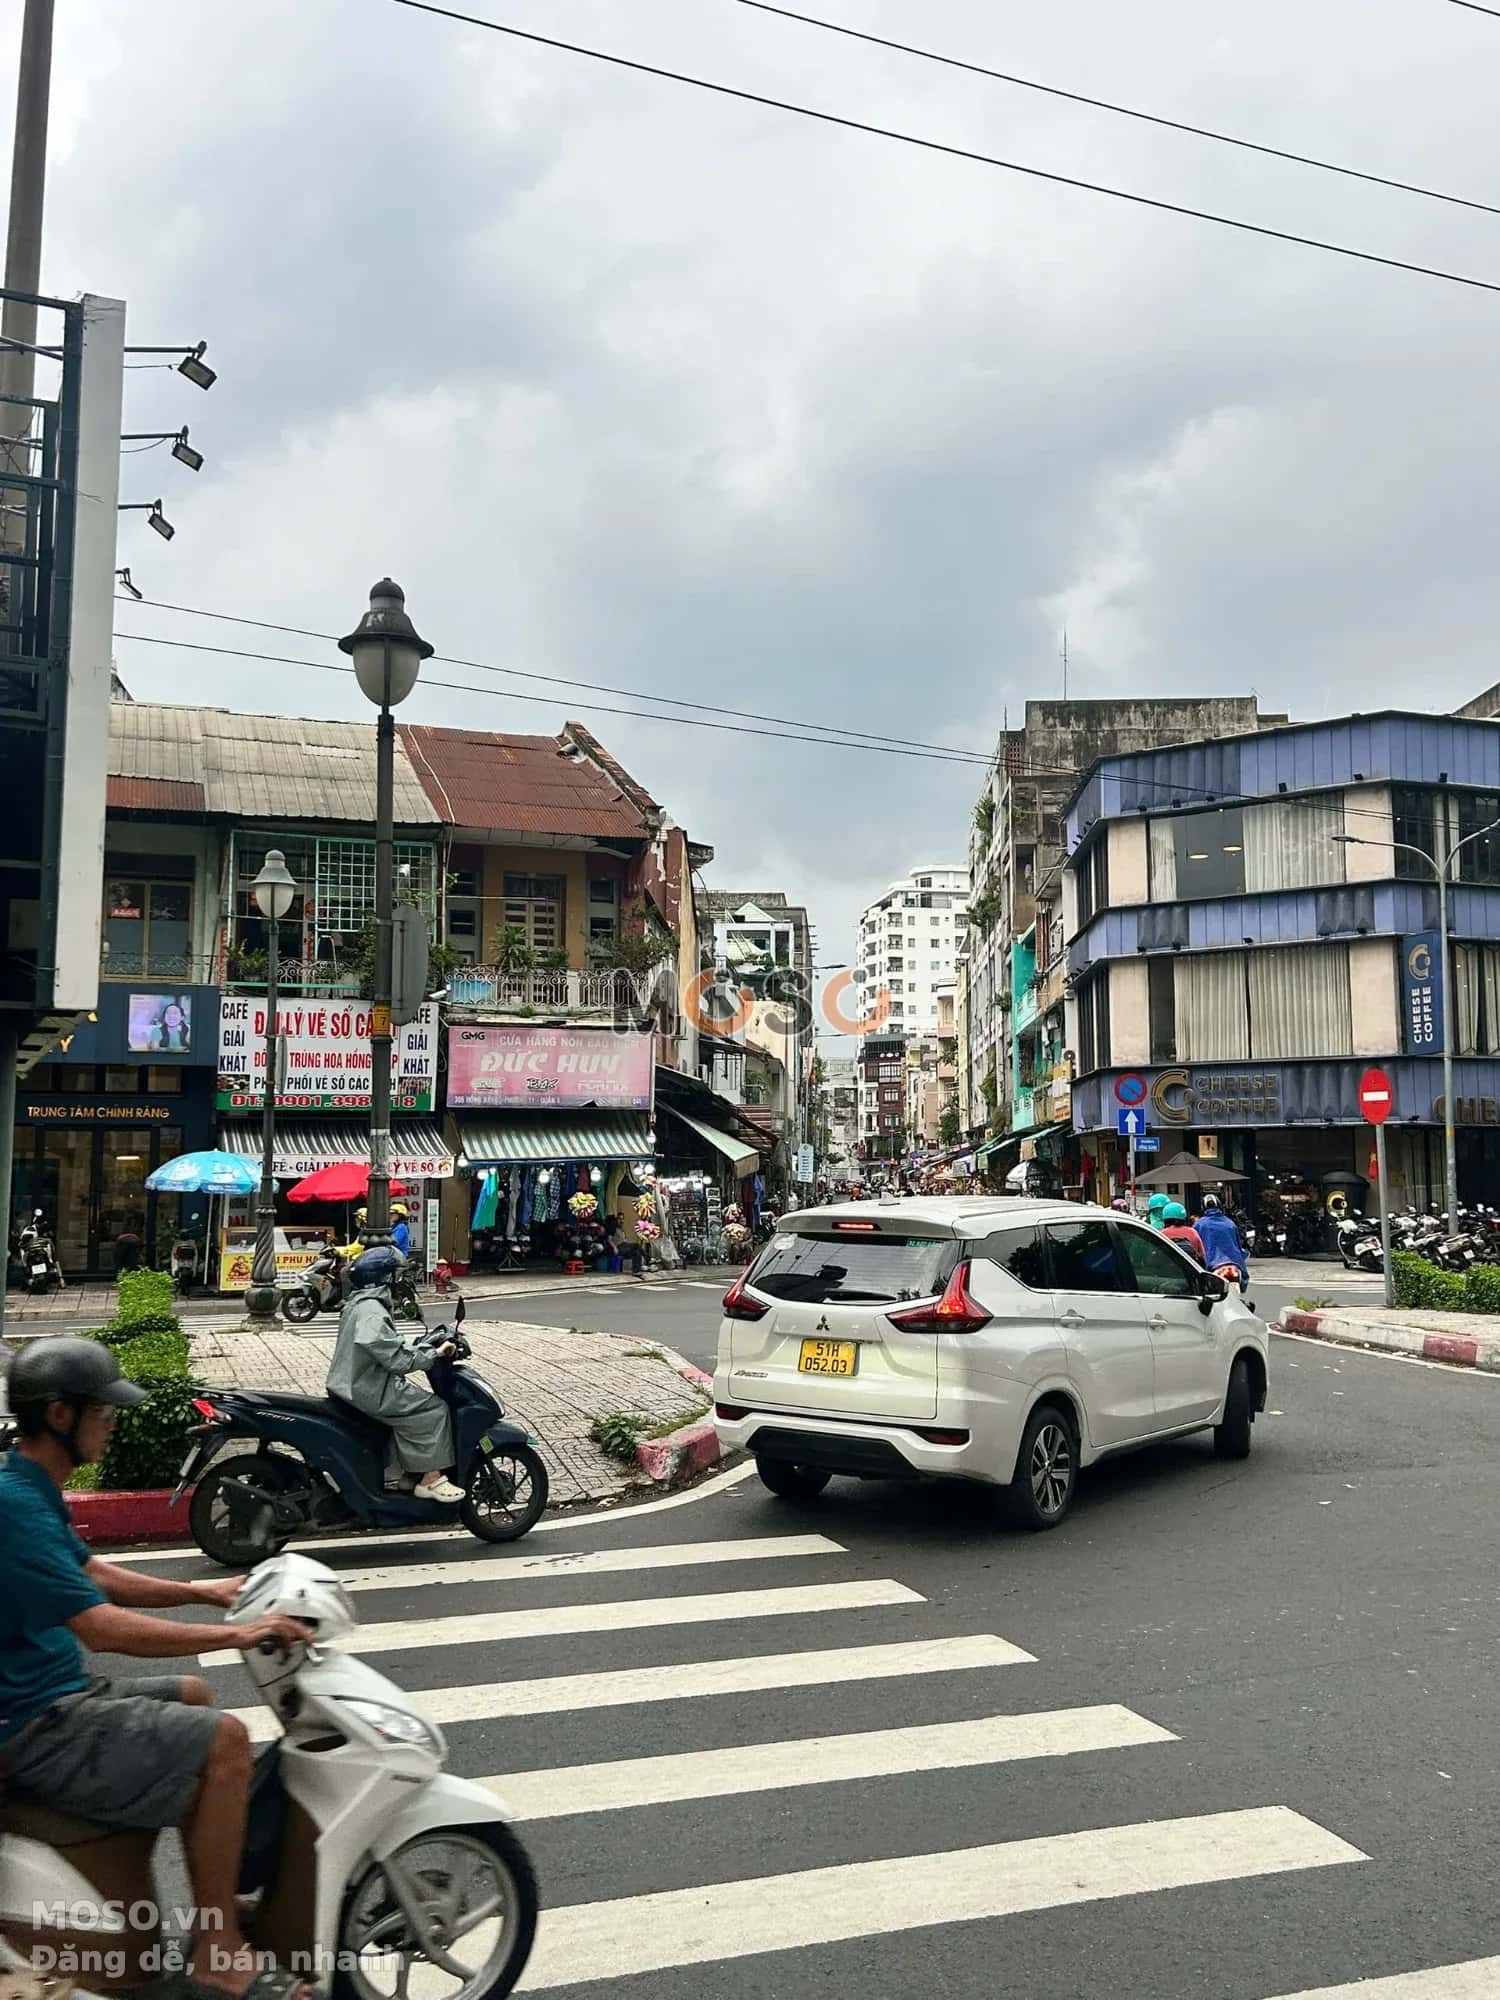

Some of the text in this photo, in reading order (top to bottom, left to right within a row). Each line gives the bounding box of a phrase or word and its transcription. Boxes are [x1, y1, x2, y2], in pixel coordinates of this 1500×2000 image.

[222, 999, 248, 1019] CAFÉ
[1411, 987, 1422, 1043] CHEESE
[1422, 986, 1433, 1042] COFFEE
[255, 1010, 281, 1035] ĐI
[285, 1006, 304, 1036] LÝ
[331, 1004, 354, 1036] SỐ
[380, 1017, 386, 1026] 7
[223, 1024, 245, 1047] GIẢI
[407, 1028, 428, 1050] GIẢI
[461, 1031, 486, 1041] GMG
[500, 1032, 522, 1047] CỬA
[220, 1051, 247, 1072] KHÁT
[289, 1048, 321, 1069] TRÚNG
[323, 1052, 343, 1069] HOA
[403, 1054, 430, 1075] KHÁT
[480, 1048, 621, 1073] ĐỨC HUY
[287, 1072, 312, 1090] PHỐI
[331, 1072, 346, 1090] SỐ
[348, 1074, 369, 1091] CÁC
[1196, 1073, 1277, 1092] CHEESE
[27, 1106, 67, 1118] TRUNG
[69, 1104, 94, 1118] TÂM
[1196, 1096, 1278, 1115] COFFEE
[815, 1343, 840, 1357] 51H
[805, 1359, 848, 1374] 052.03
